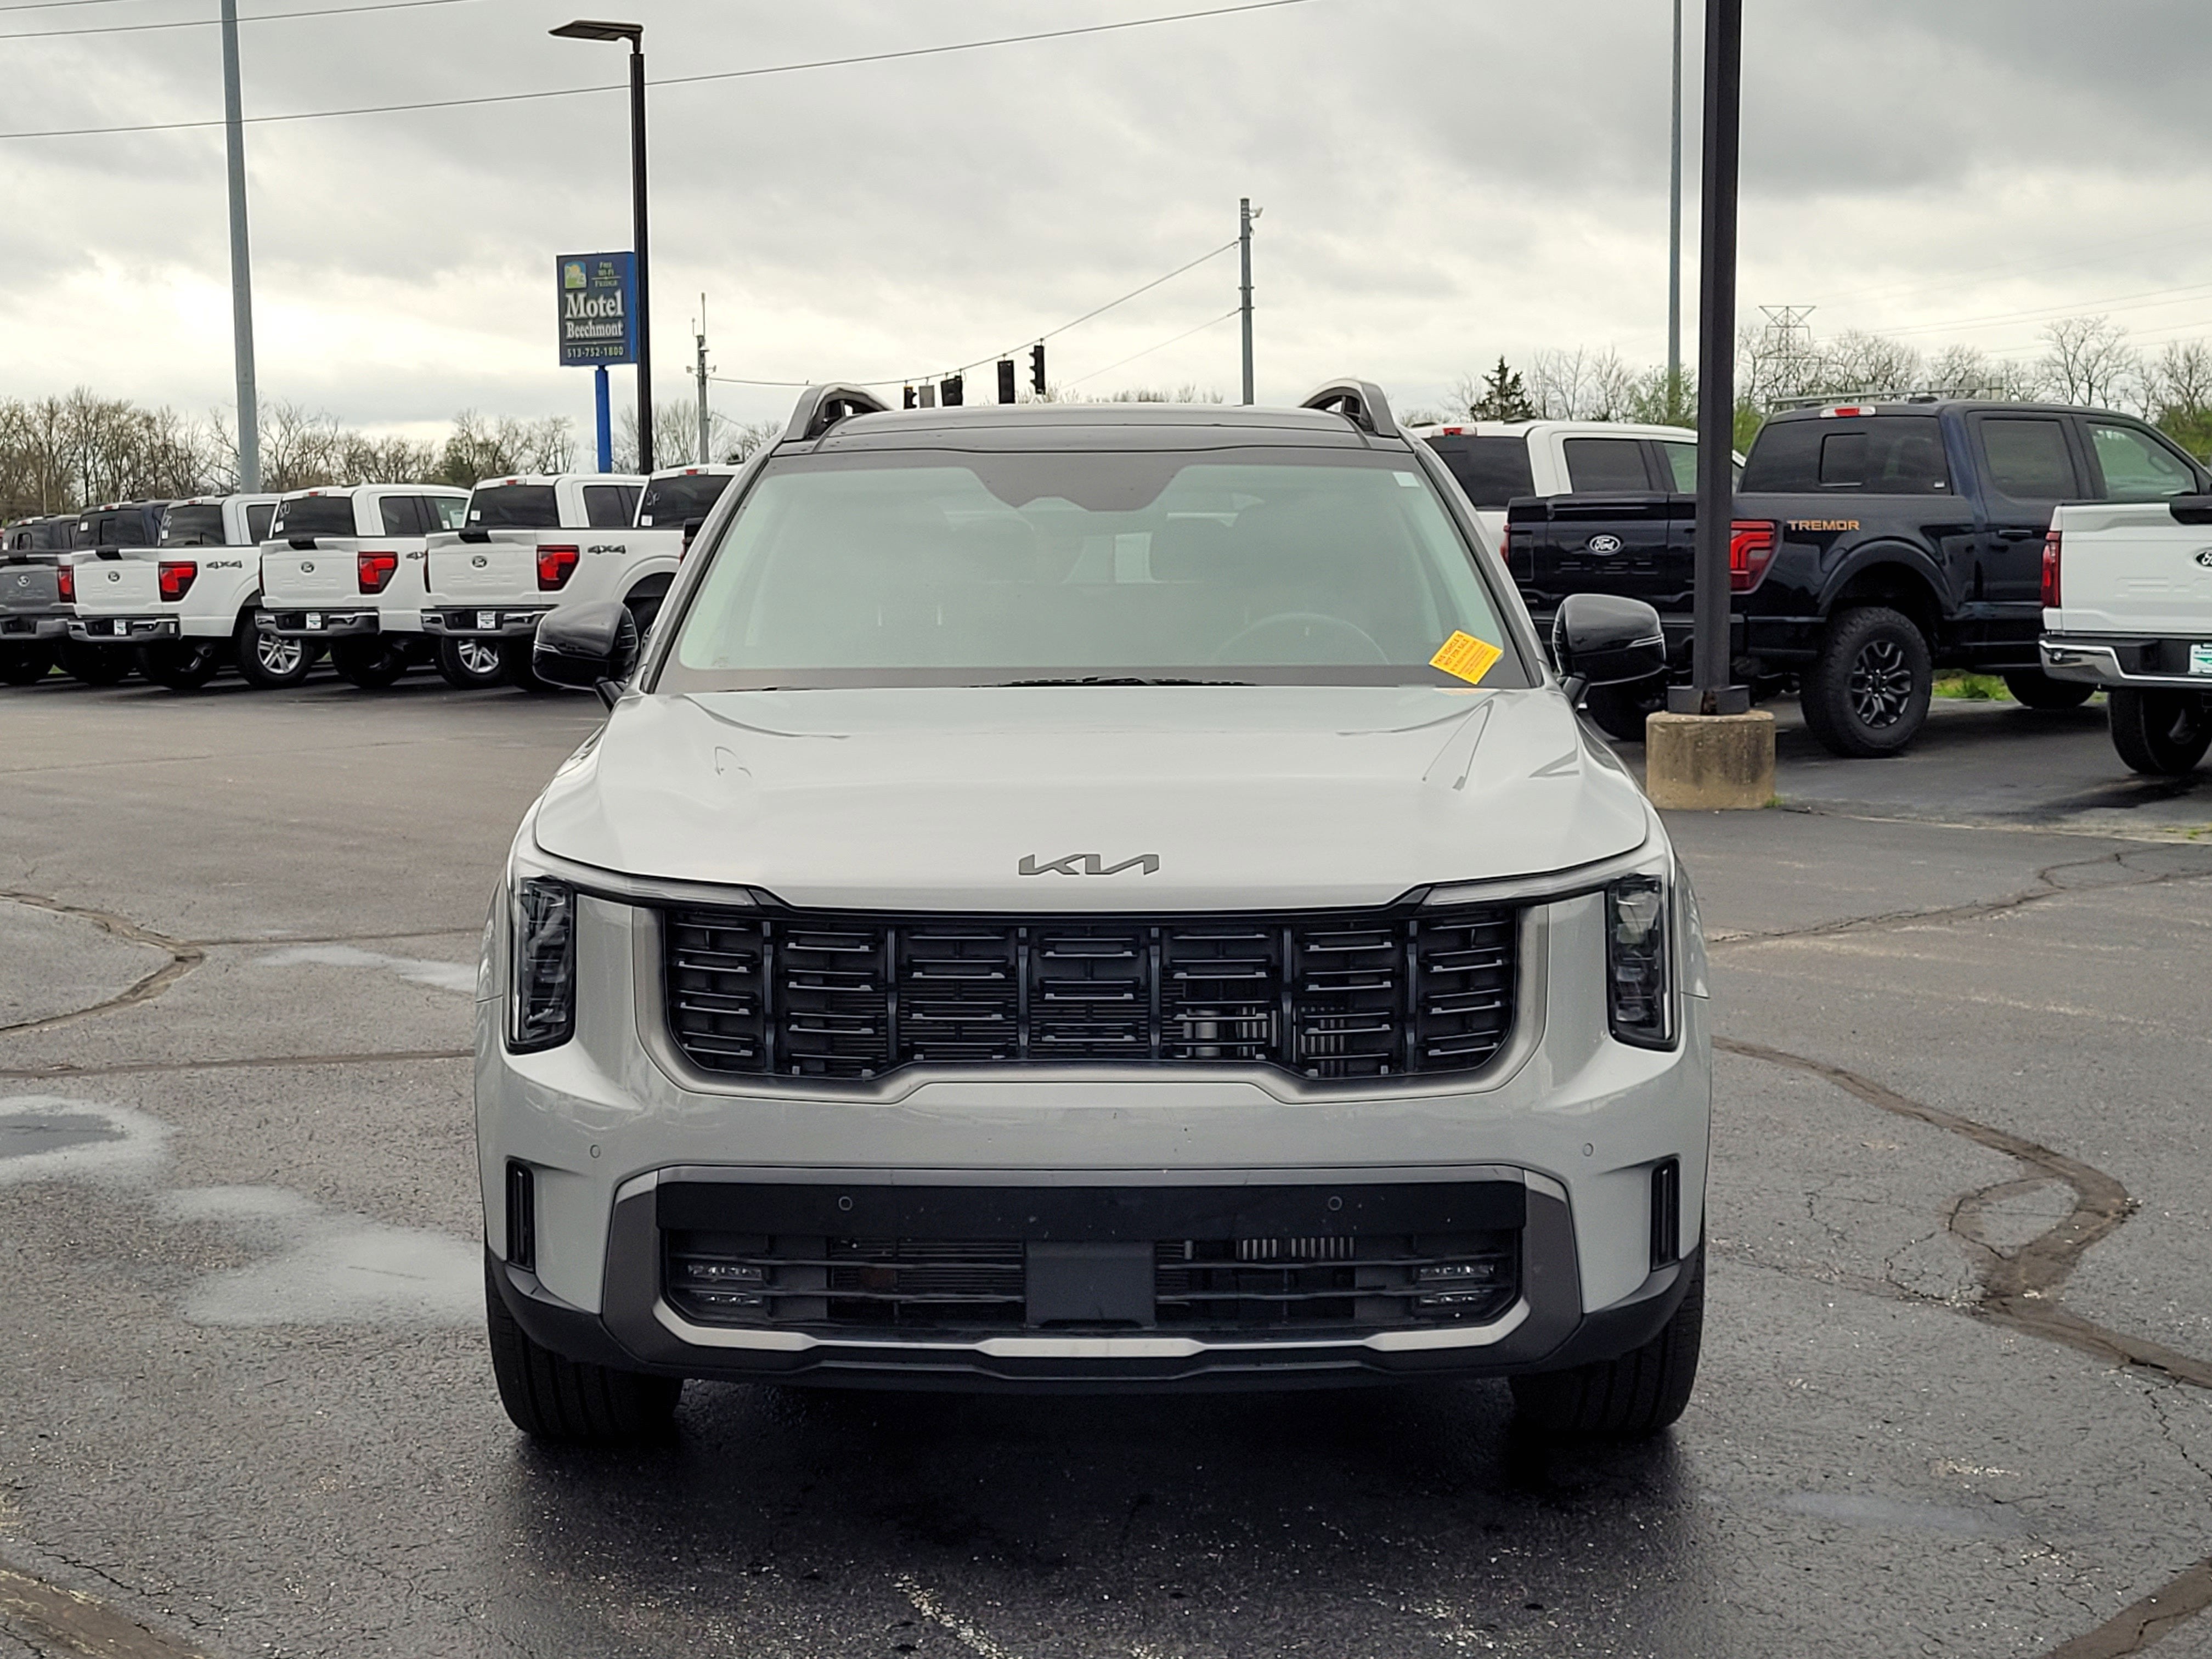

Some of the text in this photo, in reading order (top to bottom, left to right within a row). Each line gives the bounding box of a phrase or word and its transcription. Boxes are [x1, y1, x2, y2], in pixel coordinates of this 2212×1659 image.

[565, 289, 624, 319] Motel
[566, 320, 623, 338] Beechmont
[1787, 520, 1860, 531] TREMOR
[1019, 854, 1159, 875] KIA
